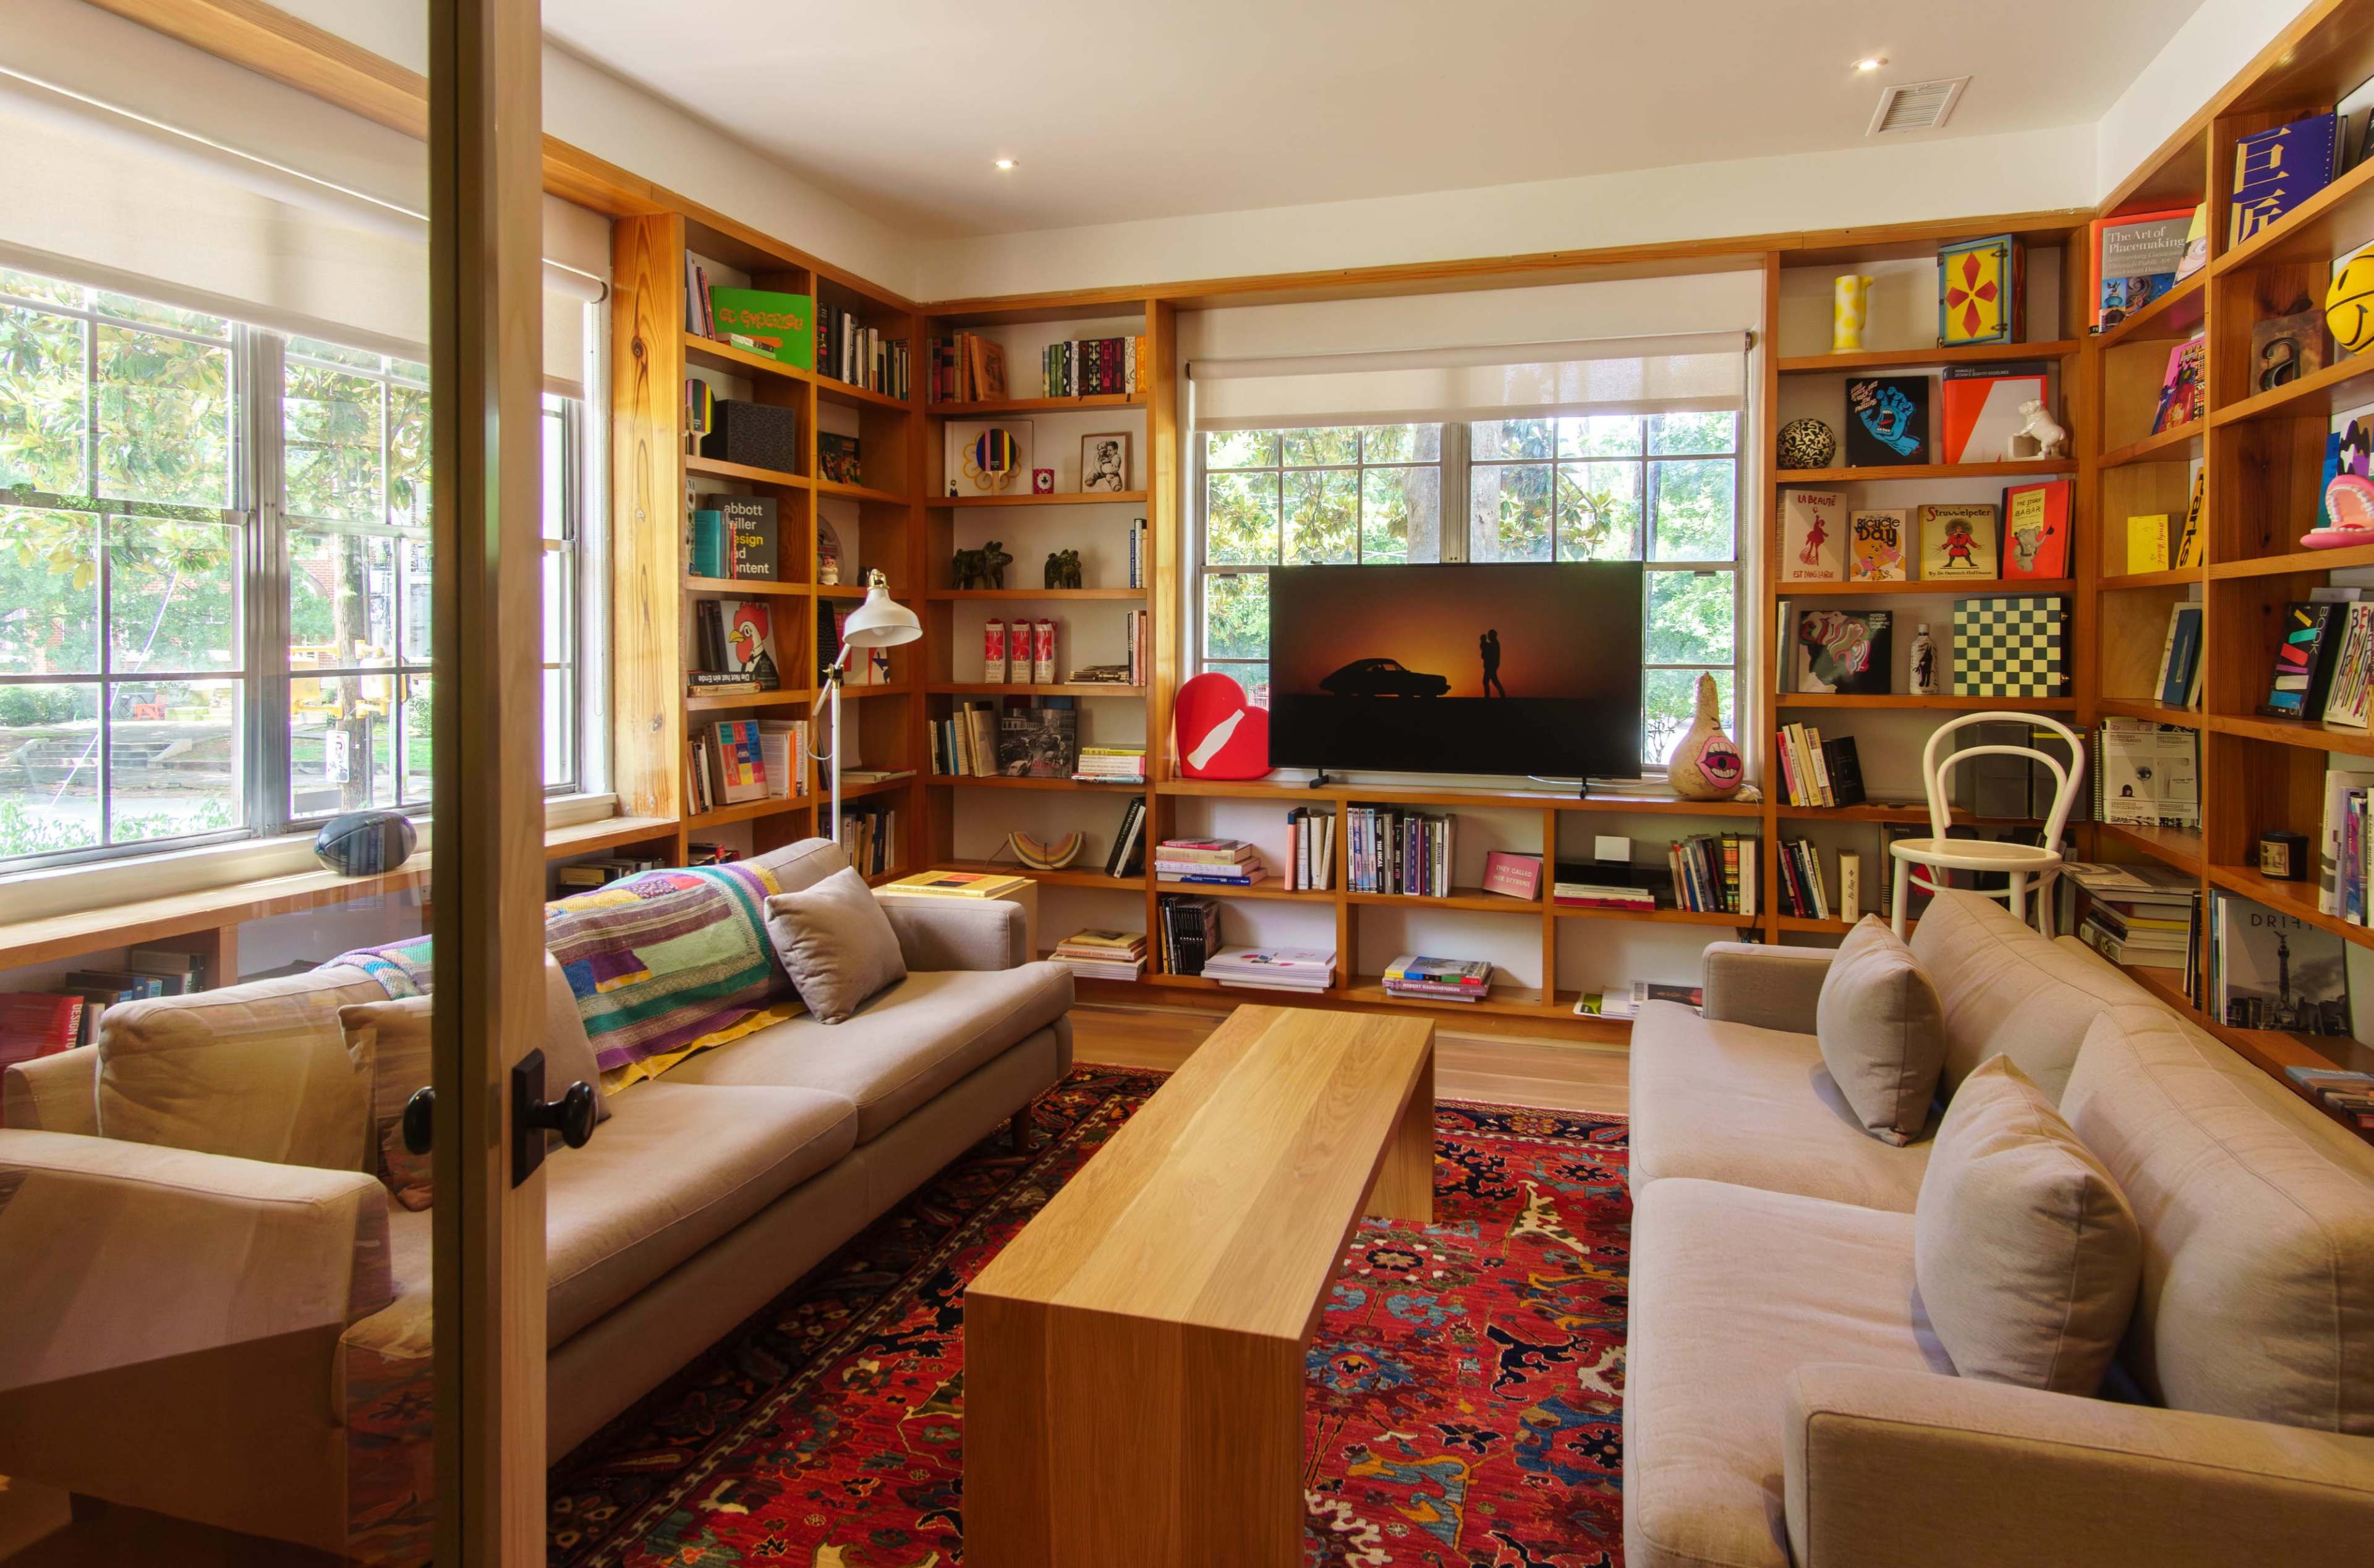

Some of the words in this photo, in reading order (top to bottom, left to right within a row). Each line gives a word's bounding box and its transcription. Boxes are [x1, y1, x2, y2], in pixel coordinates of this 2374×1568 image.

[2108, 232, 2131, 243] The
[2134, 230, 2152, 240] Art
[2153, 226, 2167, 237] of
[2109, 238, 2186, 253] Placemaking
[1798, 494, 1806, 504] LA
[1808, 494, 1837, 507] BEAUTÉ
[2027, 498, 2042, 506] STORY
[723, 502, 763, 516] abbott
[1926, 506, 1992, 522] Struwwelpeter
[2015, 506, 2041, 517] BABAR
[735, 533, 764, 548] esign
[735, 562, 770, 574] ontent
[2309, 606, 2329, 655] BOOK
[698, 675, 713, 683] Ende
[731, 674, 741, 682] Not
[1496, 865, 1509, 873] THEY
[1511, 868, 1533, 877] CALLED
[1506, 877, 1531, 888] STYRENE
[2250, 913, 2314, 931] DRIF
[1422, 984, 1460, 993] RAUSCHENBERG
[67, 1004, 83, 1035] DESIGN
[66, 1036, 77, 1048] TO
